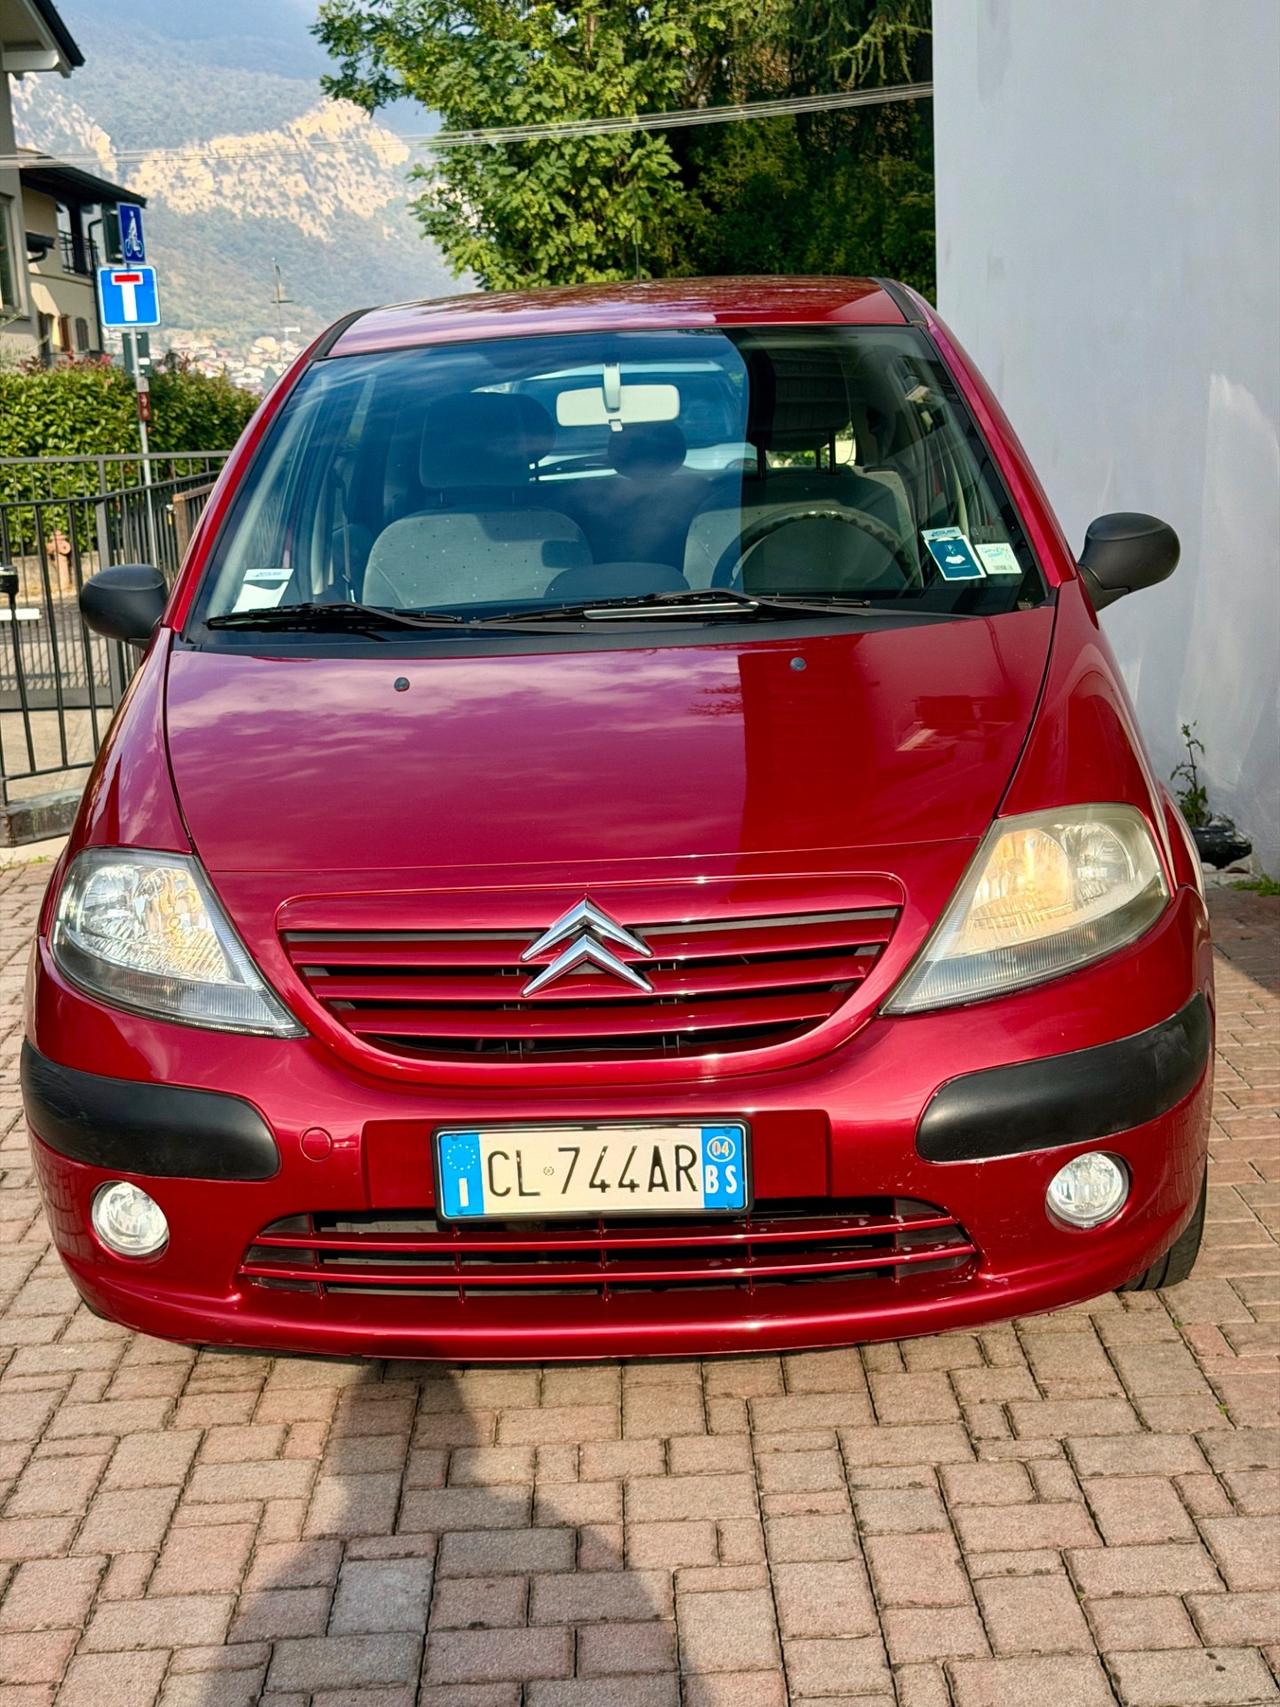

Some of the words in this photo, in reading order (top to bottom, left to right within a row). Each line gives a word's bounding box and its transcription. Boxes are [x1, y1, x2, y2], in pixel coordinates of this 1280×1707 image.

[711, 1139, 730, 1156] 04
[487, 1150, 541, 1197] CL
[558, 1144, 699, 1195] 744AR
[705, 1165, 738, 1194] BS
[458, 1177, 469, 1207] I
